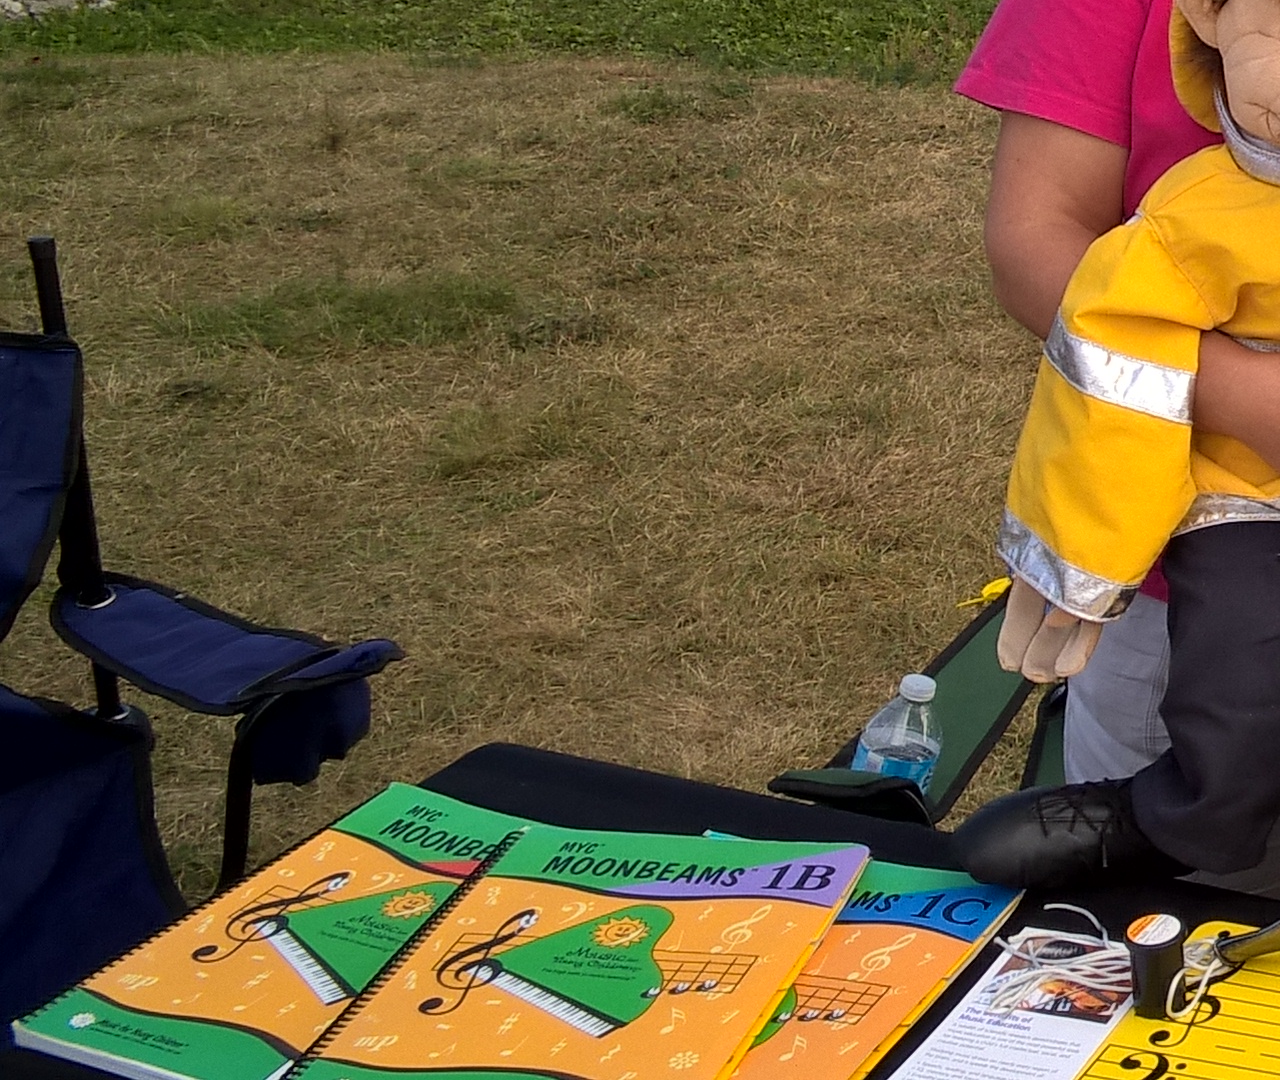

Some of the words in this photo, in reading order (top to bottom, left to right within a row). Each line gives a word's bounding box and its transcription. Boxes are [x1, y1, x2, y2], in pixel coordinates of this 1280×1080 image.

[405, 805, 443, 823] MYC
[559, 841, 598, 854] MYC
[542, 855, 746, 888] MOONBEAMS
[760, 863, 837, 893] 1B
[910, 893, 992, 926] 1C
[957, 1013, 986, 1022] Music
[985, 1018, 1033, 1031] Education
